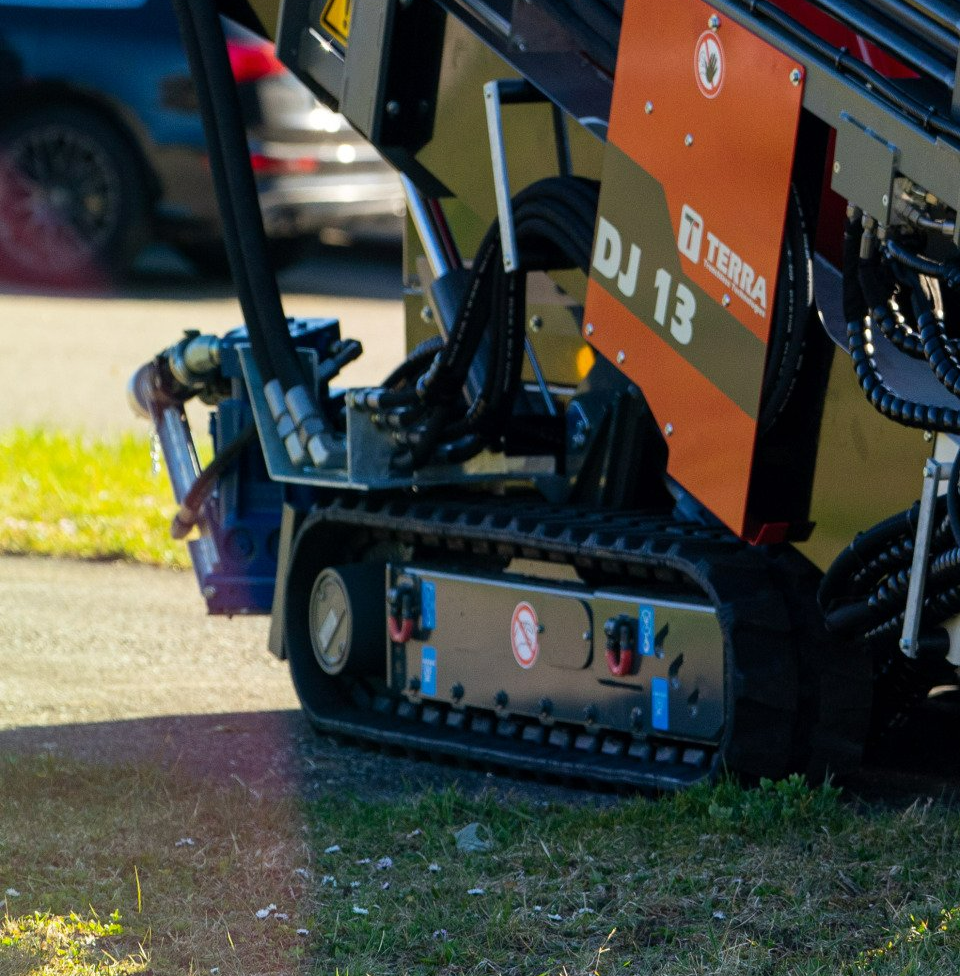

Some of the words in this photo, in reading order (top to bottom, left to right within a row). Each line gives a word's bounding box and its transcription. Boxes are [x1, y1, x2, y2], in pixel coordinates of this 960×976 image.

[591, 215, 642, 299] DJ
[653, 267, 697, 346] 13
[706, 230, 768, 311] TERRA
